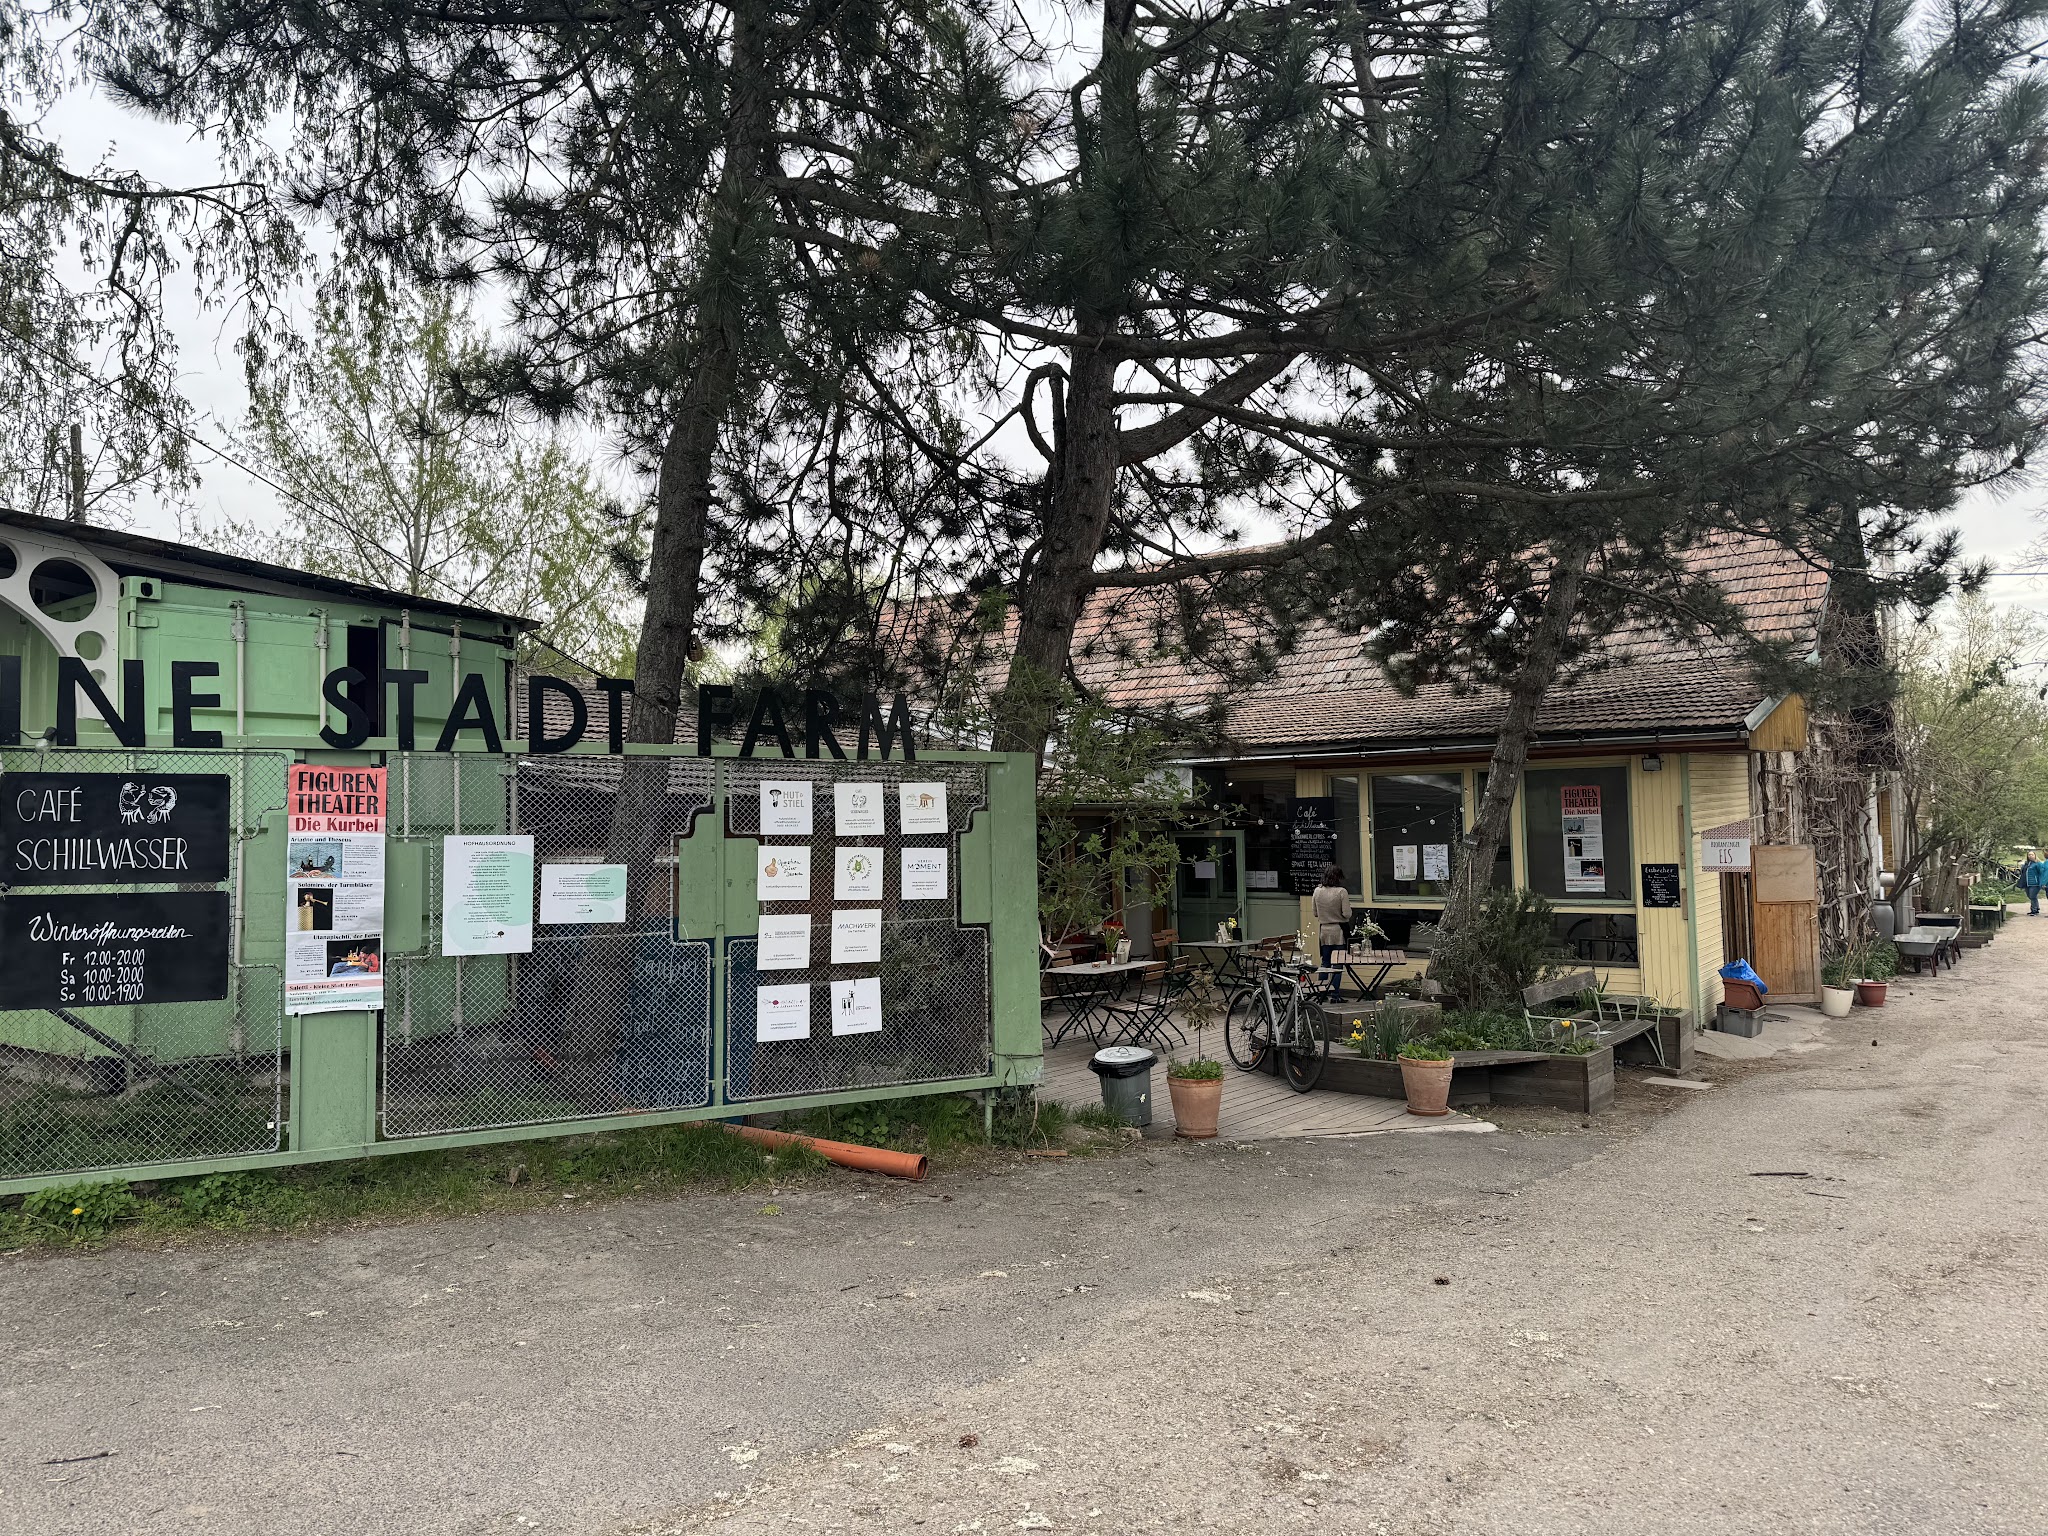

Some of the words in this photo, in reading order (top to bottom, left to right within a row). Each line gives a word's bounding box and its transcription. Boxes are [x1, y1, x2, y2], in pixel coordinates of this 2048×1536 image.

[319, 666, 635, 754] STADT
[697, 684, 916, 761] FARM
[297, 771, 378, 793] FIGUREN
[783, 791, 800, 799] HUT
[1564, 789, 1597, 799] FIGUREN
[16, 786, 83, 822] CAFÉ
[295, 793, 379, 815] THEATER
[783, 799, 805, 808] STIEL
[1564, 798, 1598, 808] THEATER
[295, 817, 321, 832] Die
[326, 817, 379, 832] Kurbel
[15, 837, 189, 871] SCHILLWASSER
[1719, 848, 1733, 864] EIS
[28, 912, 194, 947] Winteröffnungszeiten
[837, 922, 877, 930] MACHWERK
[62, 952, 75, 965] Fr
[83, 948, 145, 966] 12.00-20.00
[60, 969, 76, 985] Sa
[82, 965, 144, 984] 10.00-20.00
[60, 986, 76, 1002] So
